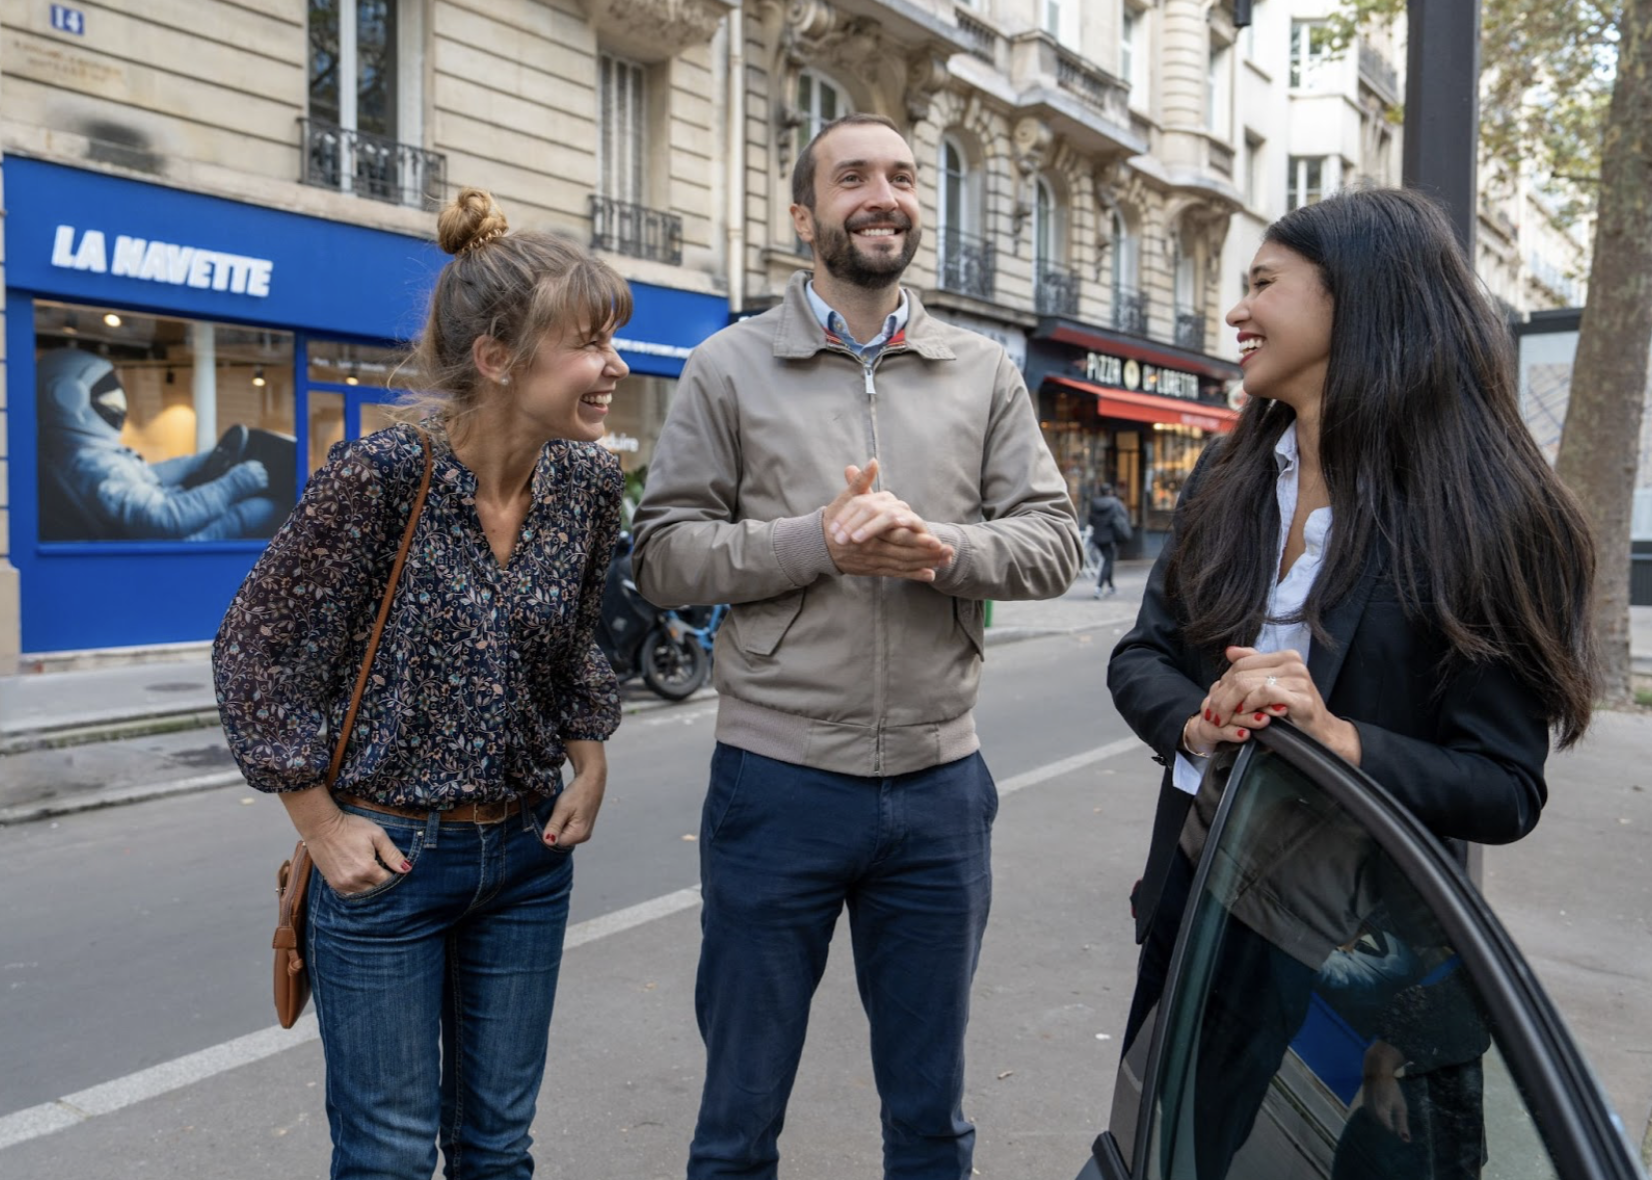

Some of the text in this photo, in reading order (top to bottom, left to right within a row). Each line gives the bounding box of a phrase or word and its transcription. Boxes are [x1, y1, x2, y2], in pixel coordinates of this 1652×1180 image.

[55, 6, 81, 33] 14
[51, 224, 274, 298] LA NAVETTE
[1087, 352, 1122, 386] PIZZA
[1157, 367, 1199, 400] LORETTA
